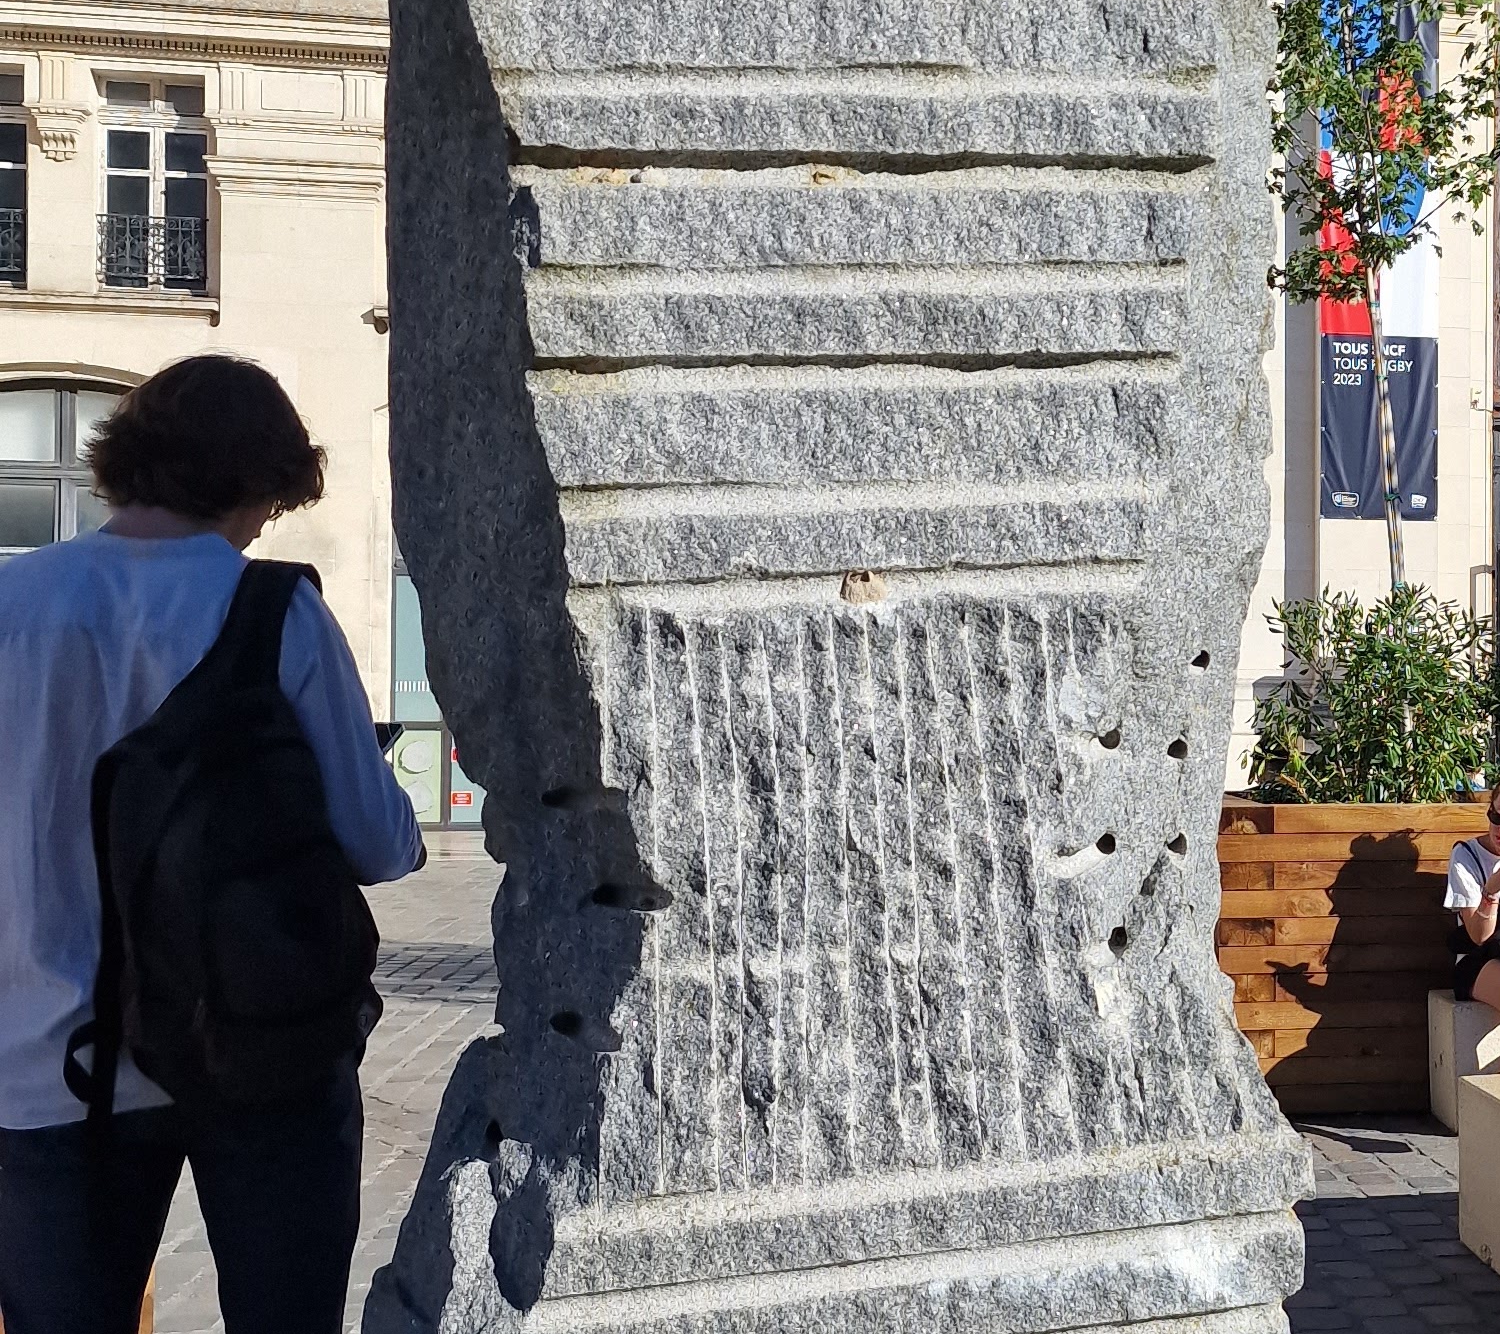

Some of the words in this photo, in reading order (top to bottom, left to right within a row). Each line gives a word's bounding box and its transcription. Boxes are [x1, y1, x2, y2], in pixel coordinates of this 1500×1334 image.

[1332, 342, 1369, 355] TOUS
[1332, 357, 1368, 371] TOUS
[1333, 372, 1362, 386] 2023
